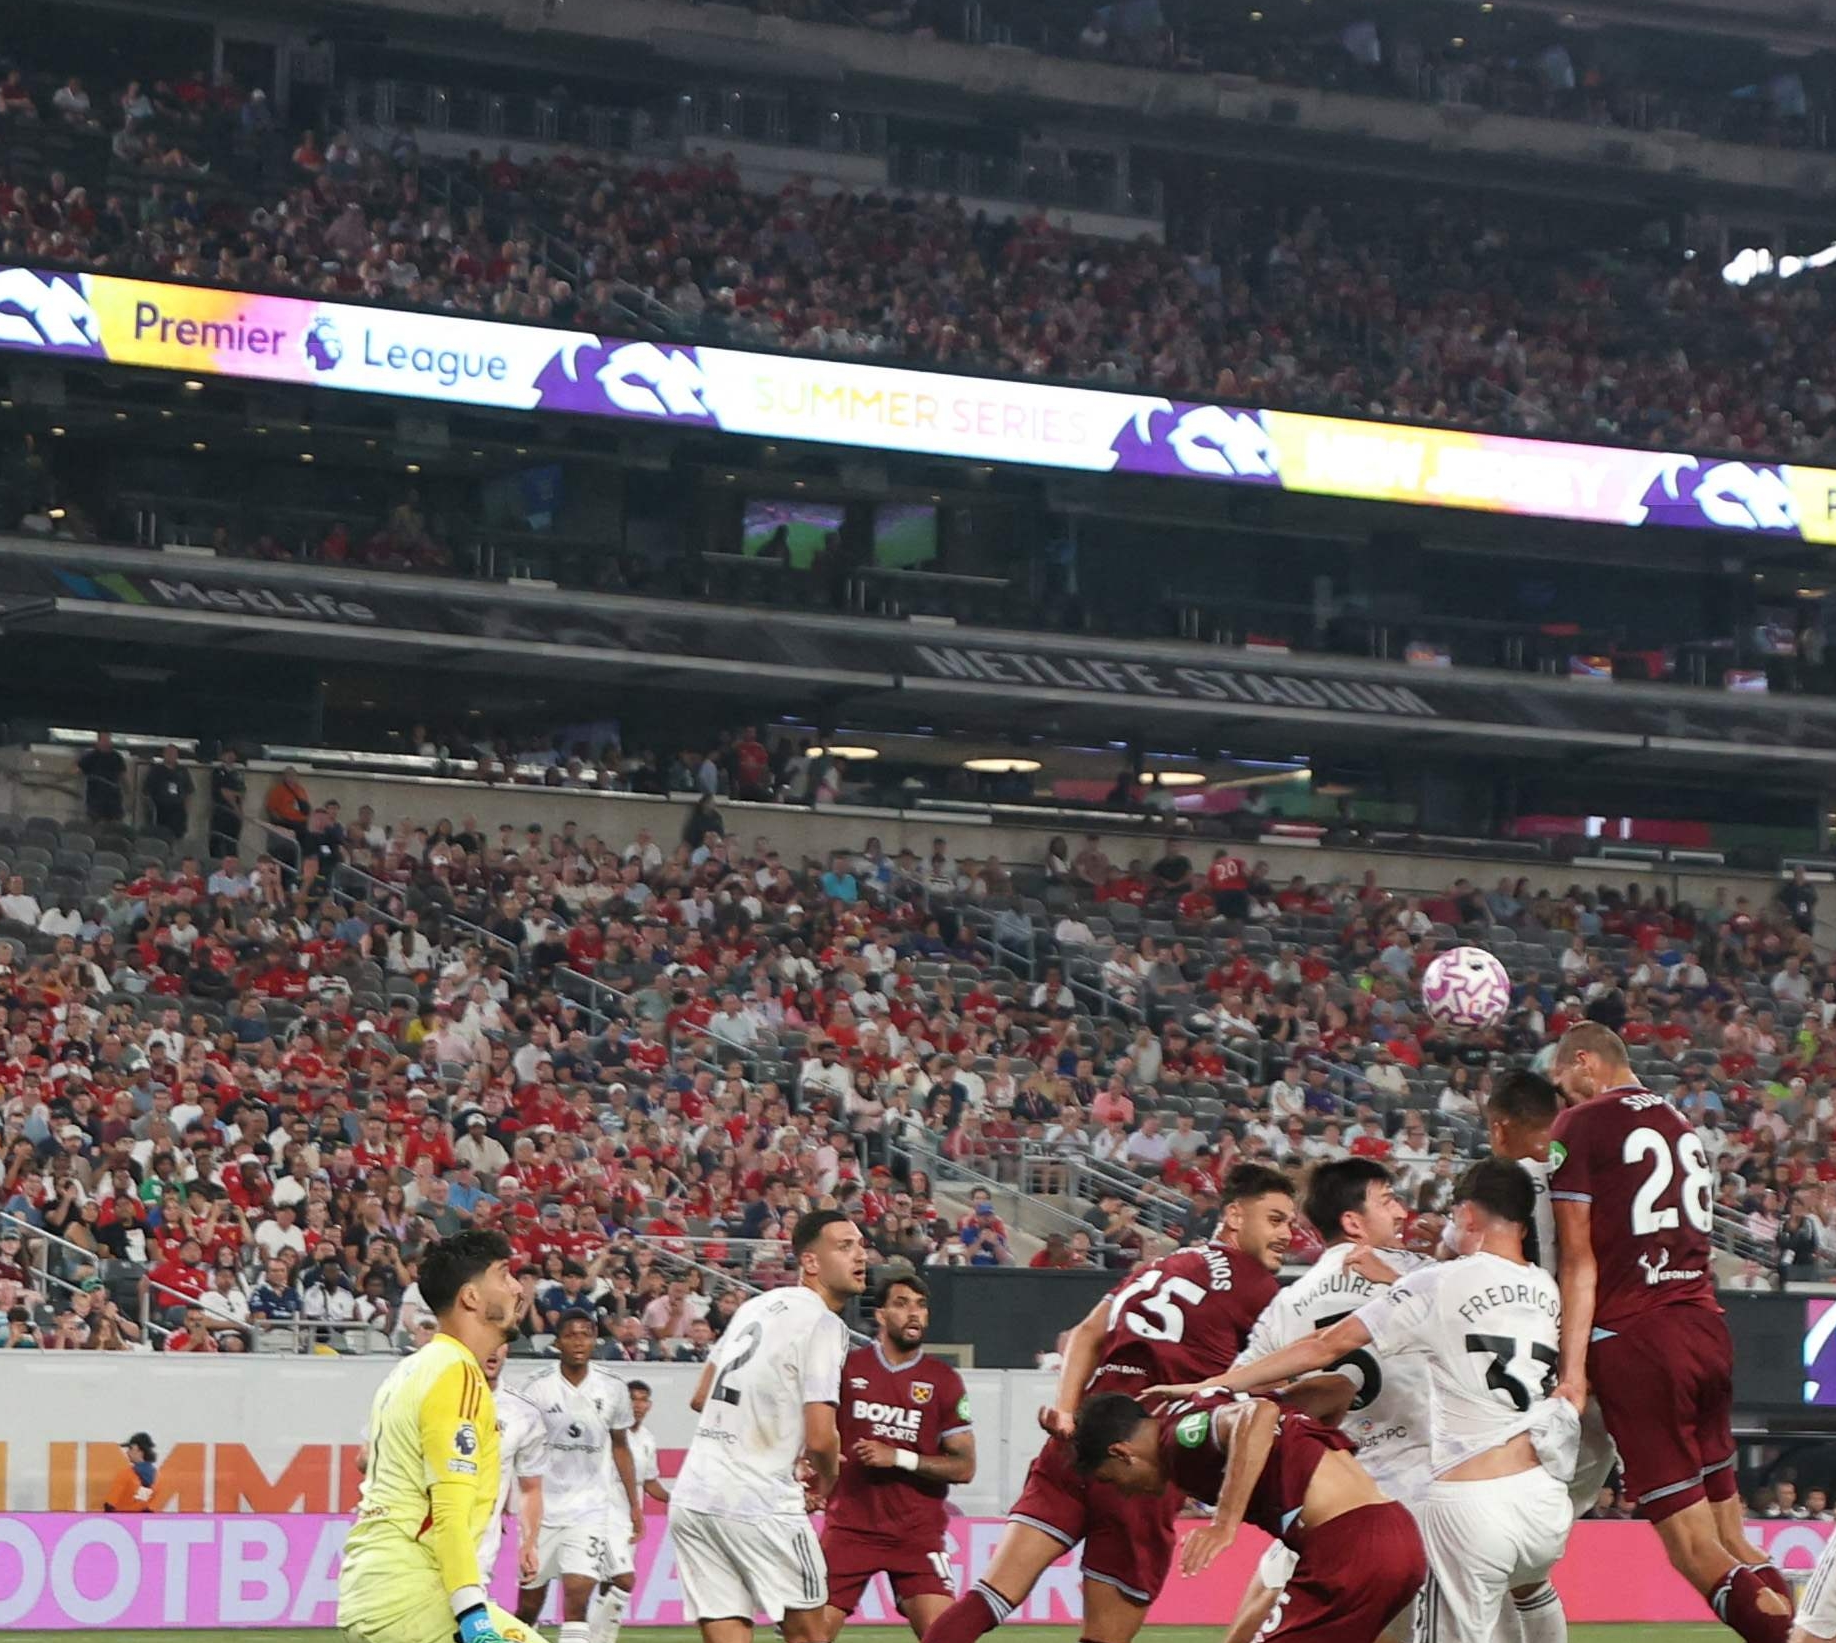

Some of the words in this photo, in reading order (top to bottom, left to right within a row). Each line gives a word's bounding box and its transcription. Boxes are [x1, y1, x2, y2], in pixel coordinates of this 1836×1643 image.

[135, 300, 287, 356] Premier
[365, 329, 508, 387] League
[754, 374, 940, 431] SUMMER
[951, 399, 1087, 446] SERIES
[148, 577, 376, 620] MetLife
[915, 644, 1178, 697] METLIFE
[1176, 666, 1438, 717] STADIUM
[1622, 1126, 1714, 1236] 28
[1107, 1270, 1208, 1344] 15
[1292, 1273, 1376, 1317] MAGUIRE
[712, 1320, 763, 1407] 2
[851, 1399, 923, 1427] BOYLE
[872, 1423, 918, 1443] SPORTS
